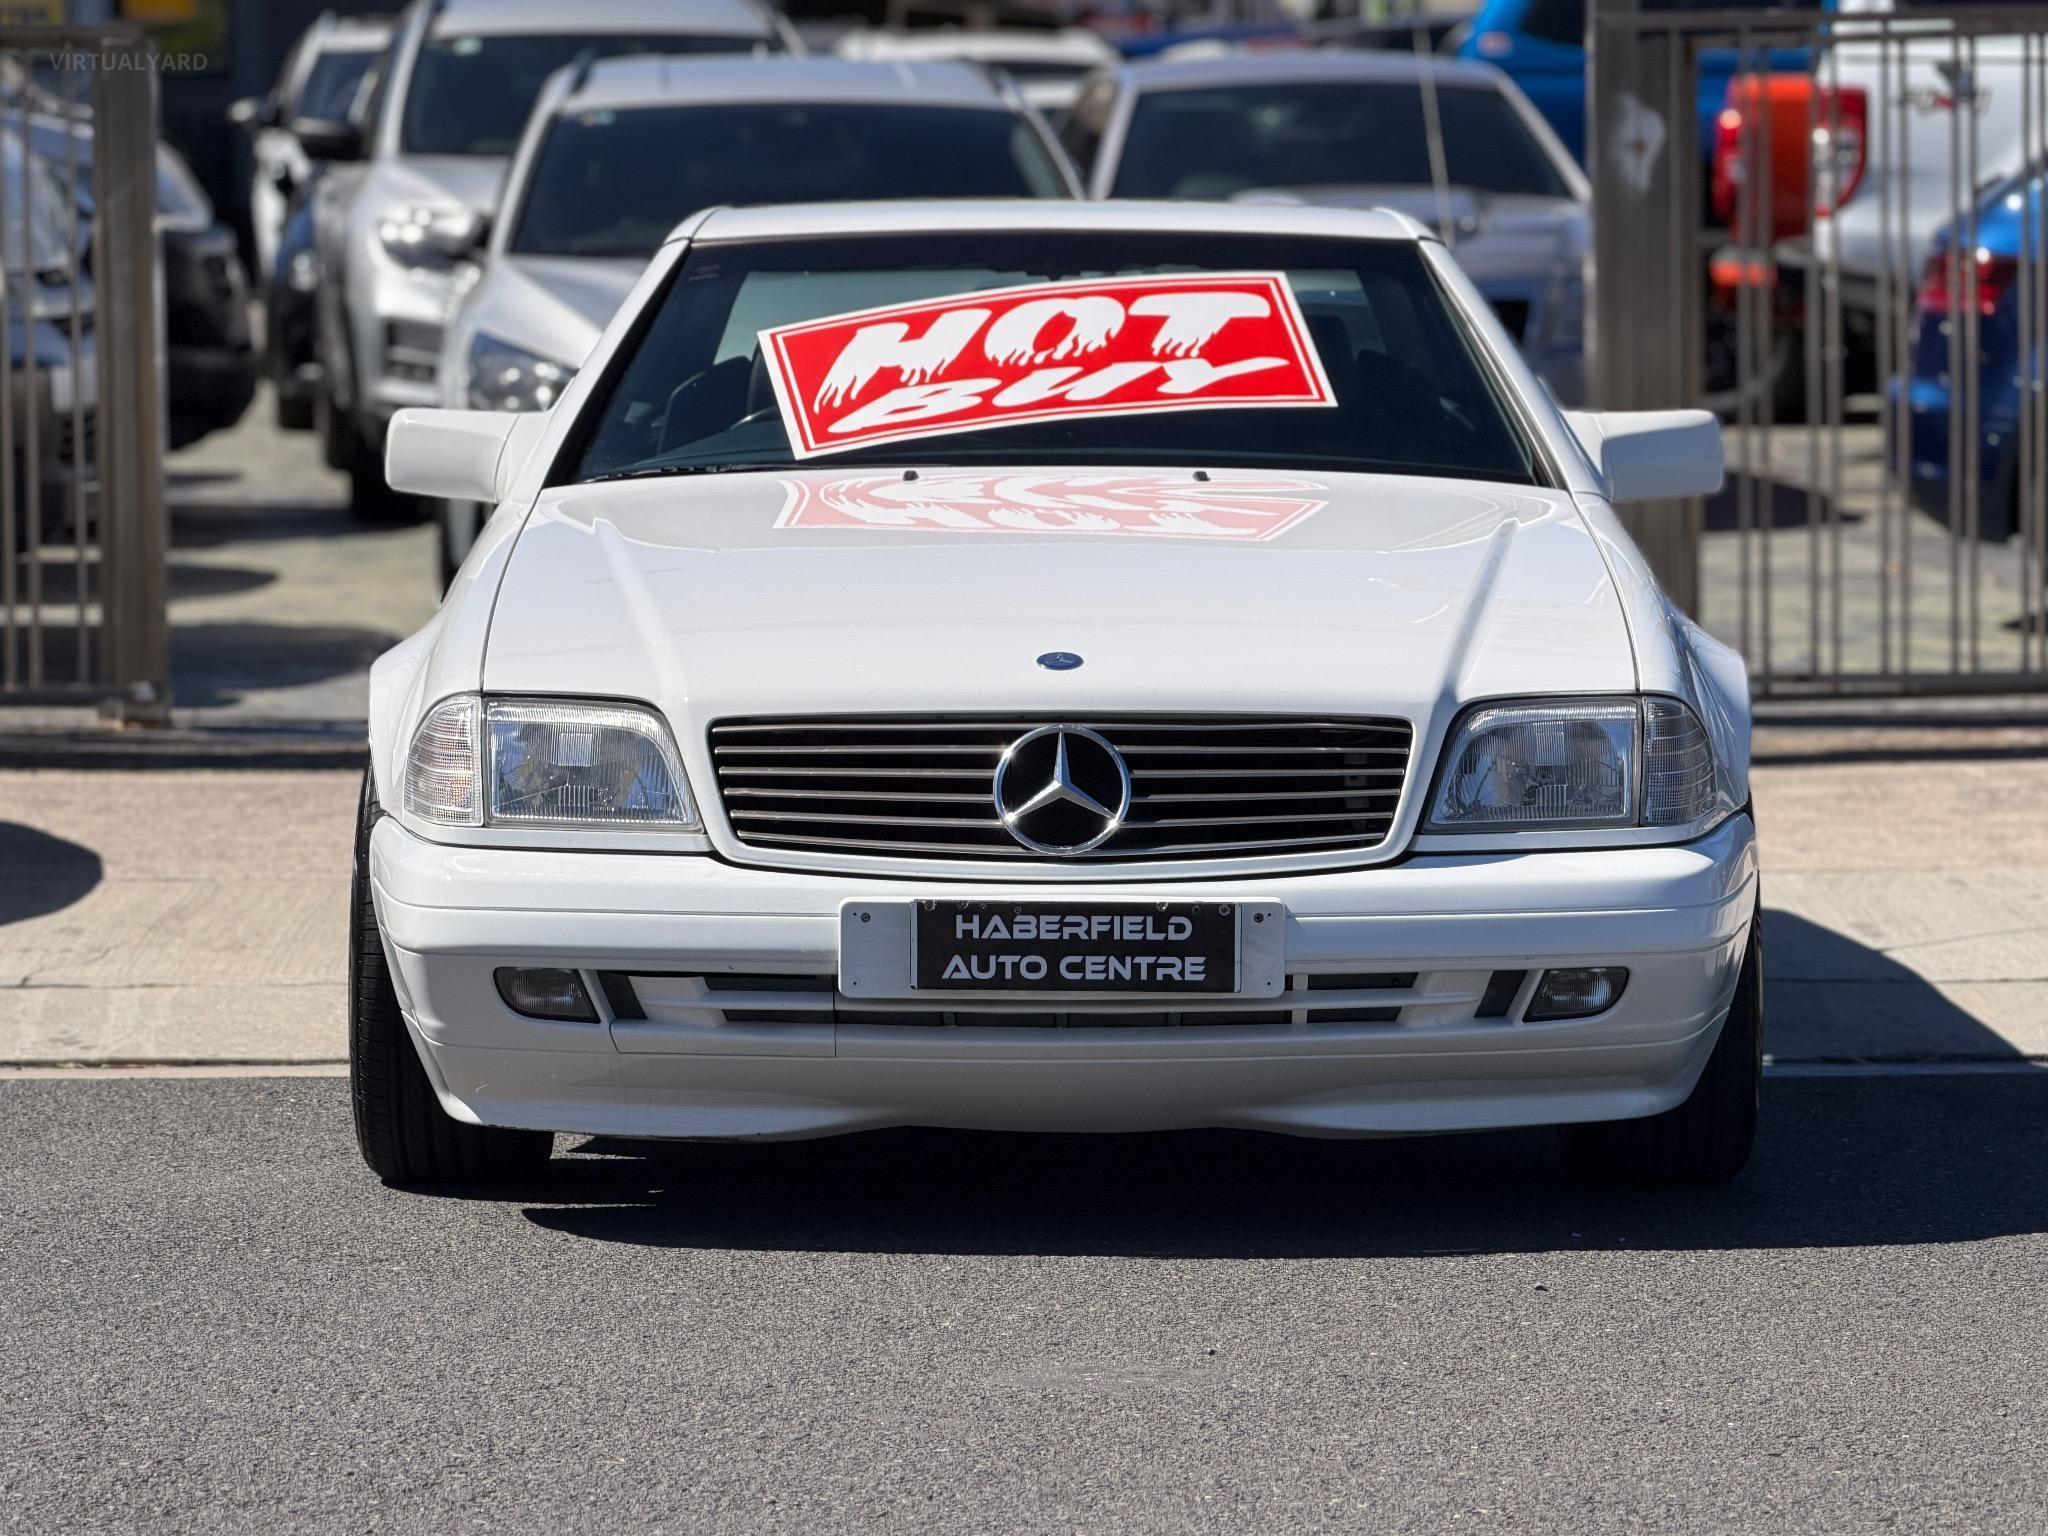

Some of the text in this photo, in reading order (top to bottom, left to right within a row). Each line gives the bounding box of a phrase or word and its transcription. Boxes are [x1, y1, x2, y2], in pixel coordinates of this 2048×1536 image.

[814, 291, 1270, 414] HOT
[827, 357, 1289, 433] BUY
[956, 914, 1193, 941] HABERFIELD
[941, 954, 1207, 981] AUTO CENTRE
